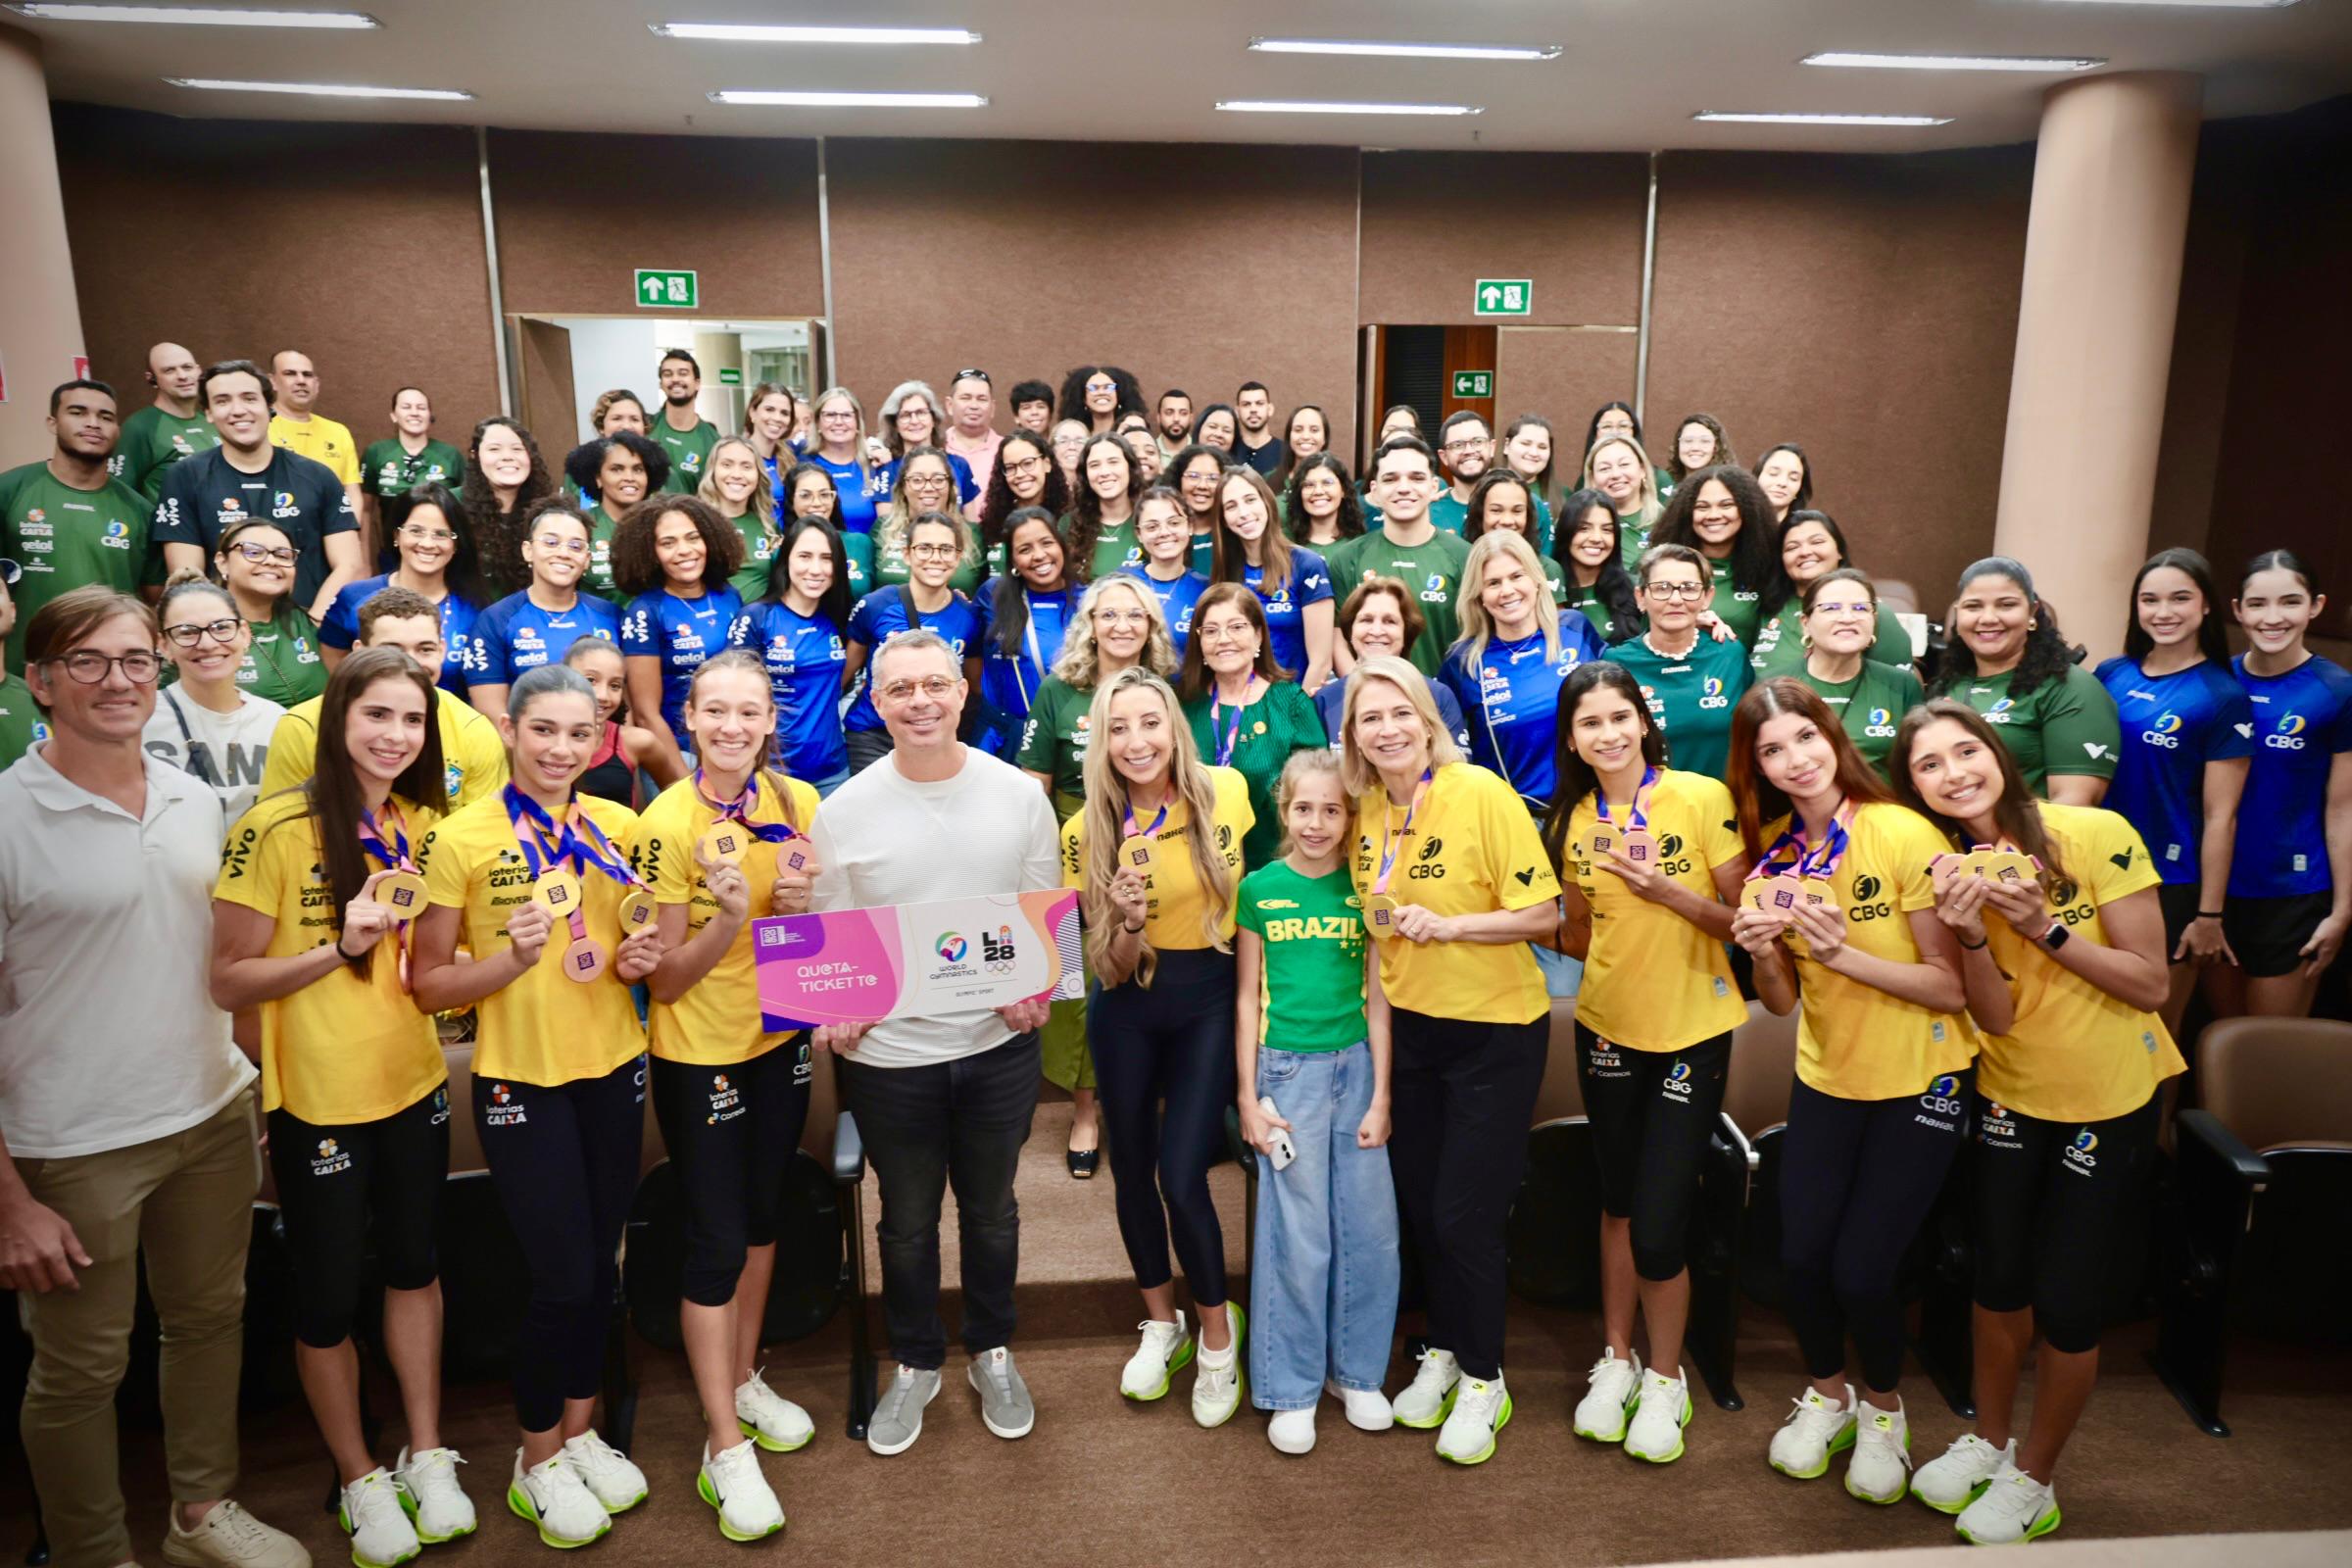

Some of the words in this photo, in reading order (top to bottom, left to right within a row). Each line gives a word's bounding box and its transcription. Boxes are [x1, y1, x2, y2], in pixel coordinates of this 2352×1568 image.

[167, 497, 180, 526] vivo
[272, 507, 300, 518] CBG
[100, 535, 130, 550] CBG
[848, 570, 863, 580] BG
[1420, 590, 1447, 603] CBG
[1734, 591, 1759, 601] CBG
[1266, 602, 1293, 613] CBG
[634, 610, 650, 643] vivo
[734, 615, 752, 645] vivo
[1175, 621, 1191, 633] CB
[473, 638, 489, 671] vivo
[1699, 696, 1728, 709] CBG
[1020, 718, 1038, 751] vivo
[1864, 725, 1896, 737] CBG
[2142, 730, 2179, 749] CBG
[2265, 734, 2305, 750] CBG
[229, 828, 256, 879] vivo
[643, 838, 662, 884] vivo
[488, 865, 529, 877] loteria
[1409, 863, 1446, 879] CBG
[1849, 903, 1890, 922] CBG
[1264, 916, 1361, 942] BRAZIL
[984, 945, 1015, 961] 28
[929, 969, 978, 980] GYMNASTICS
[939, 963, 967, 972] WORLD
[799, 977, 855, 993] TICKET
[856, 974, 878, 988] TO
[1592, 1057, 1621, 1067] CAIXA
[1663, 1077, 1692, 1094] CBG
[486, 1103, 525, 1115] loterias
[712, 1096, 740, 1110] CAIXA
[1920, 1095, 1961, 1116] CBG
[487, 1112, 527, 1126] CAIXA
[1983, 1123, 2016, 1137] CAIXA
[311, 1151, 351, 1168] loterias
[2065, 1145, 2097, 1167] CBG
[314, 1160, 353, 1176] CAIXA
